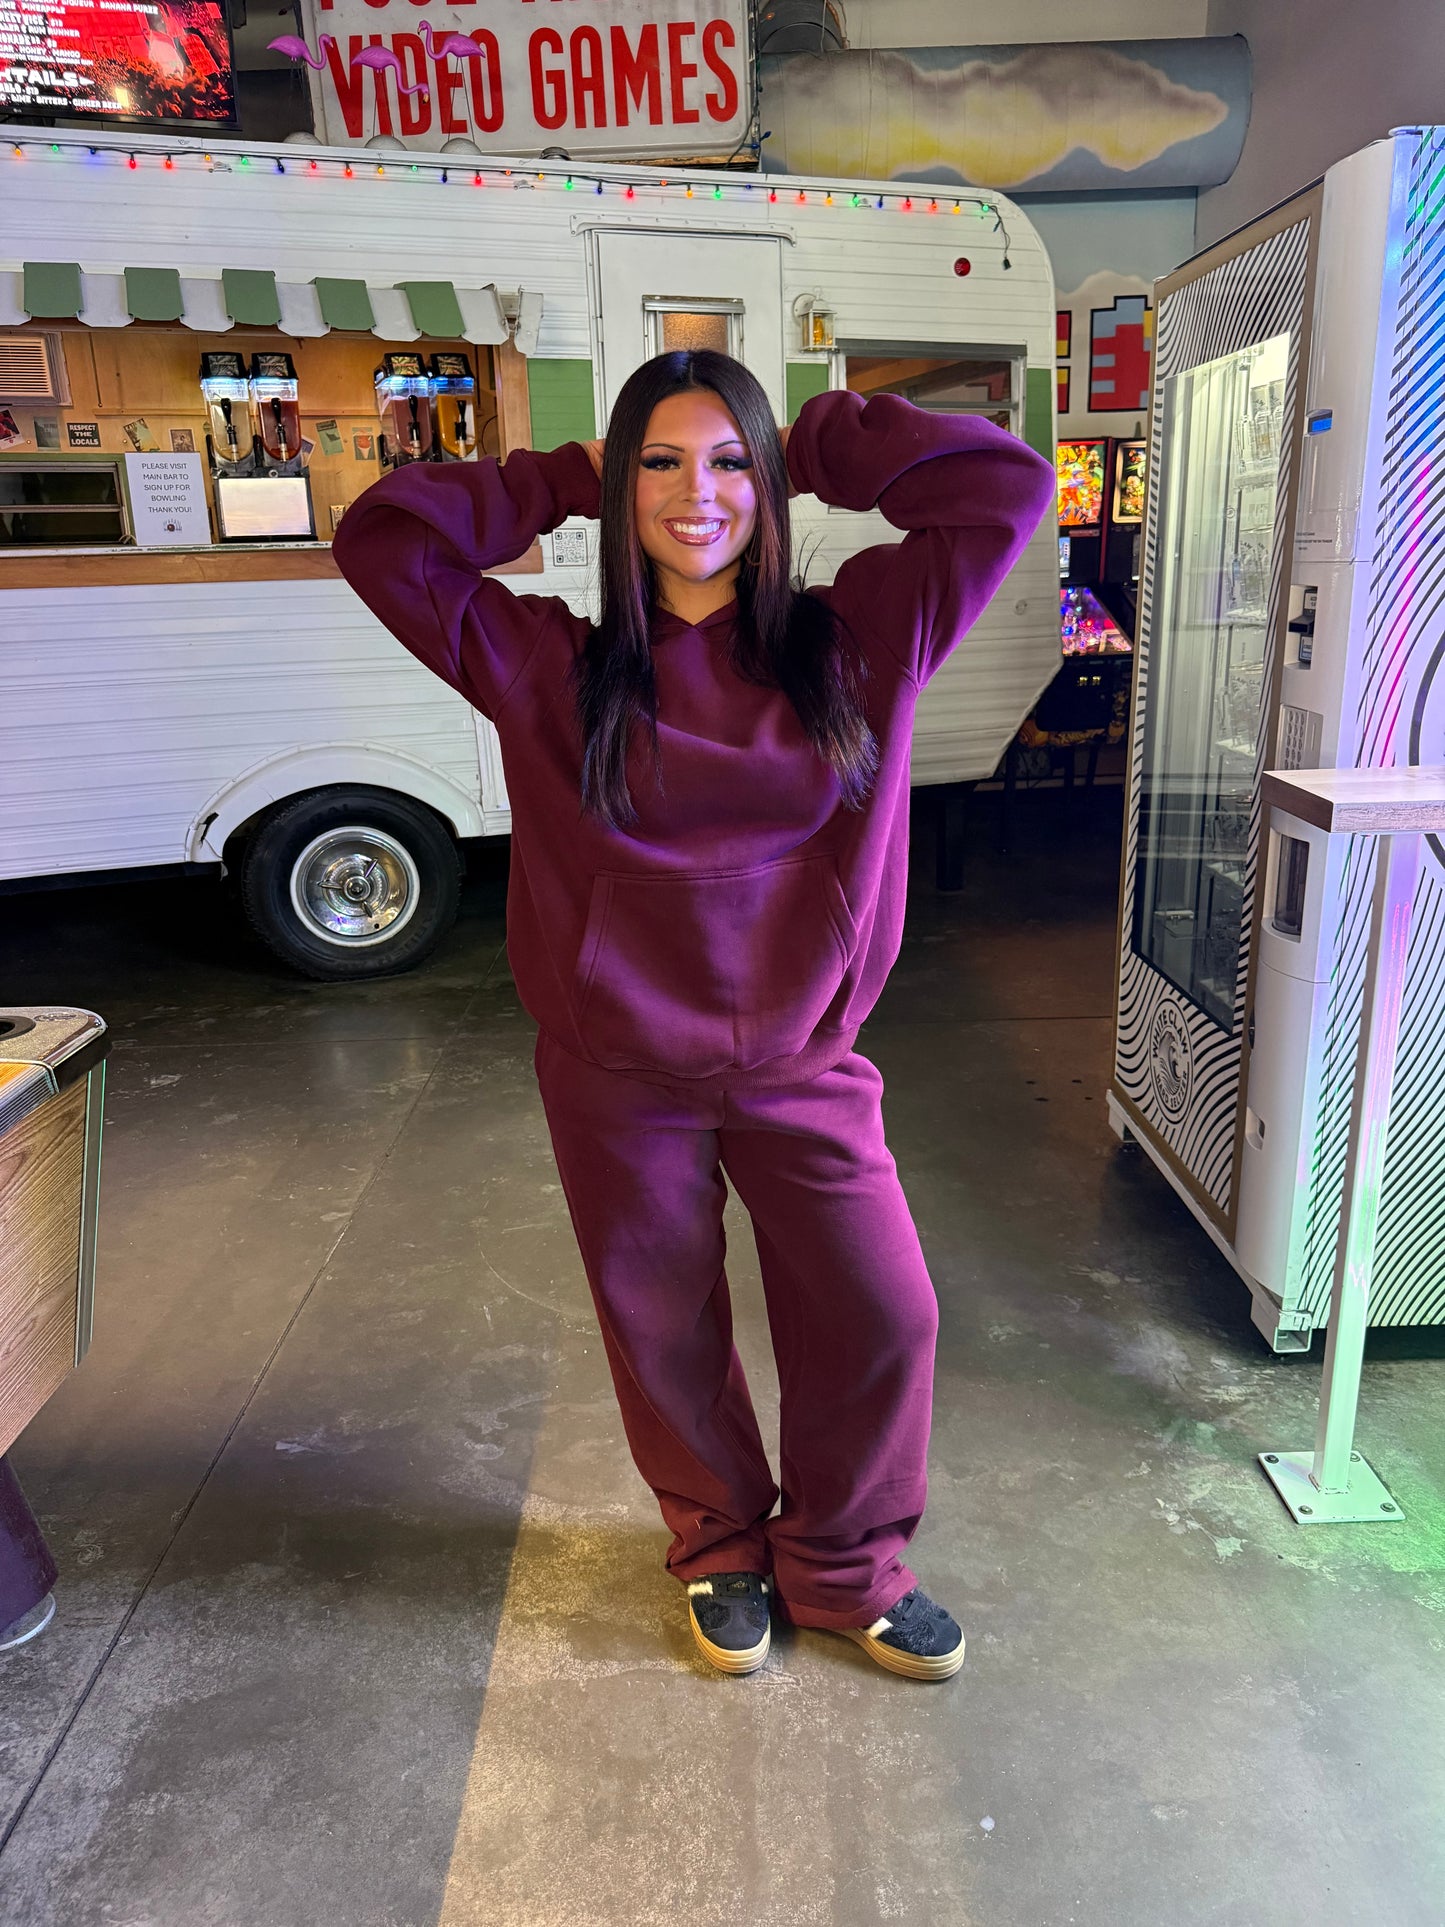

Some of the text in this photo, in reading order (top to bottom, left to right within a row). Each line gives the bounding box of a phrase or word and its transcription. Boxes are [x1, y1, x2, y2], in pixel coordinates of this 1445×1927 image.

[22, 3, 66, 14] PINEAPPLE
[101, 1, 132, 12] BANANA
[133, 4, 158, 15] PUREE
[47, 26, 80, 38] RUNNER
[19, 46, 47, 56] HONEY
[52, 48, 81, 58] MANGO
[327, 19, 738, 138] VIDEO GAMES
[36, 96, 68, 106] BITTERS
[72, 98, 101, 108] GINGER
[1152, 1009, 1188, 1058] WHITE CLAW
[1157, 1070, 1187, 1108] HARD SELTZER
